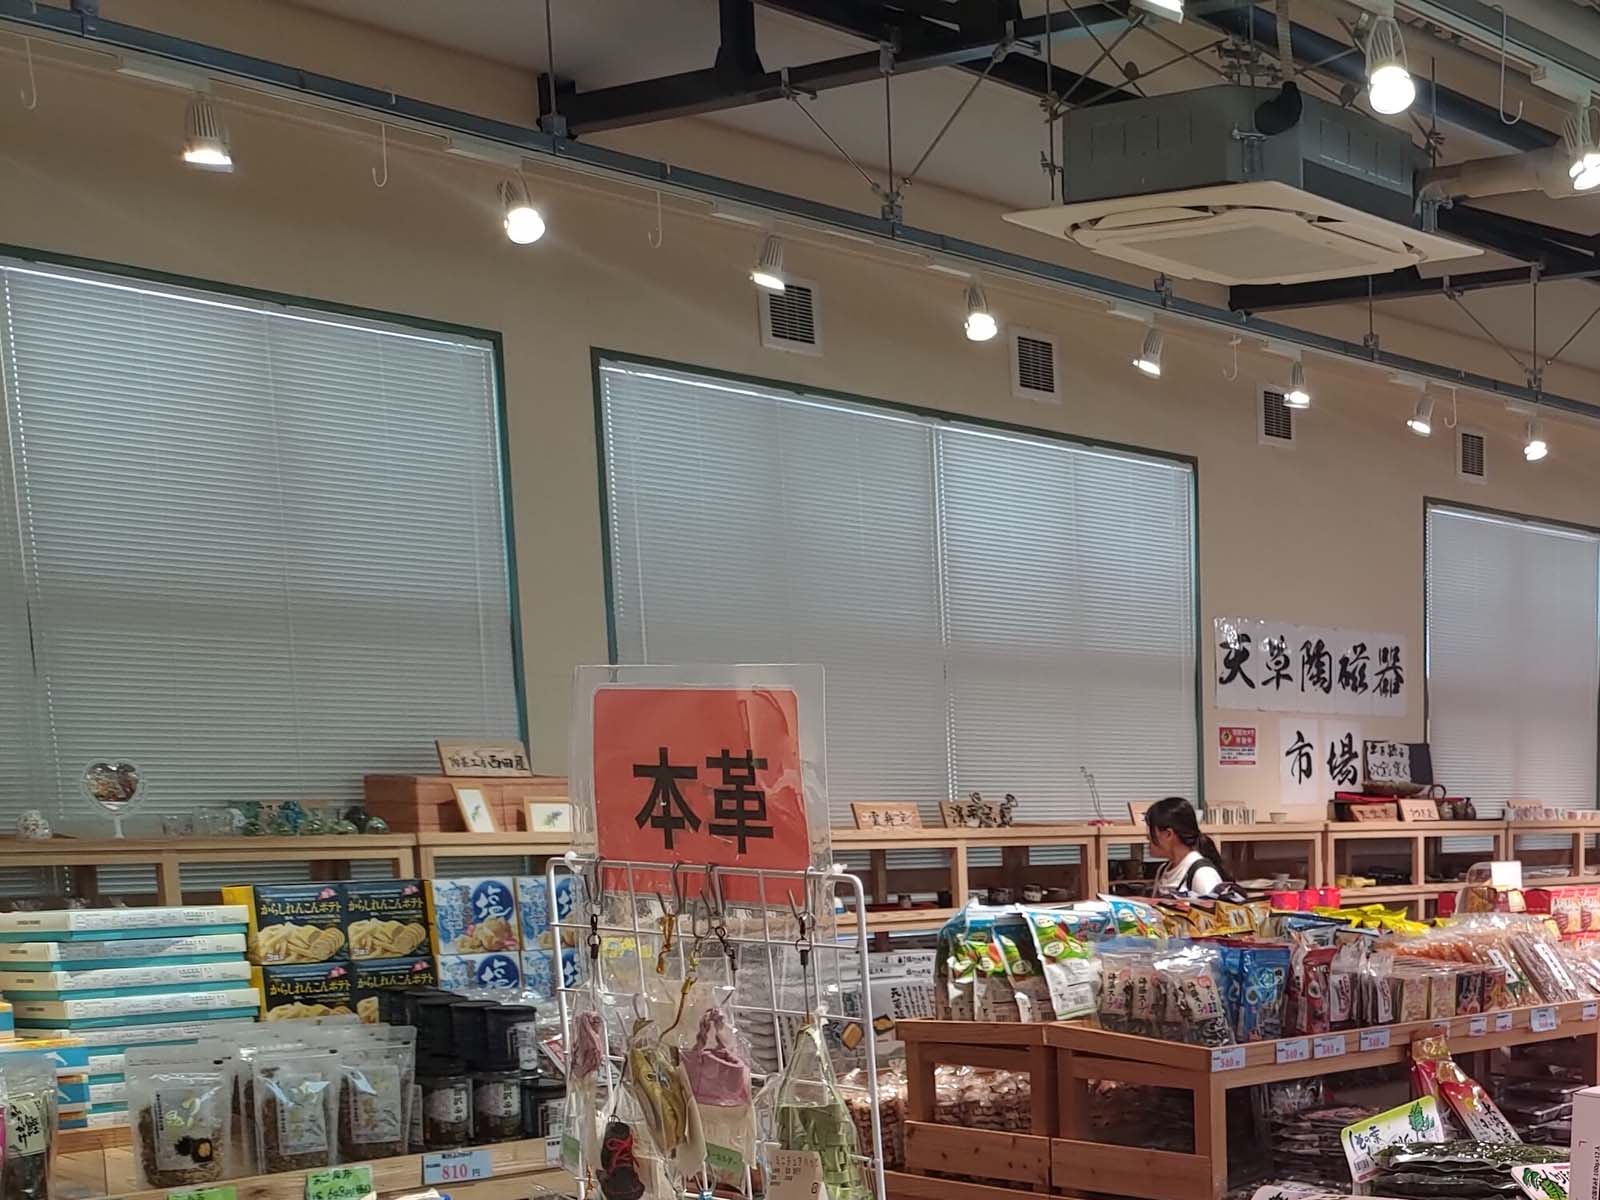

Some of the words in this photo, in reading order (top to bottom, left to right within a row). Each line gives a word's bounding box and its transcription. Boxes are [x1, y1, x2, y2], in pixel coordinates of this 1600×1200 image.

[1218, 633, 1405, 697] 天草陶磁器
[1285, 731, 1359, 786] 市場
[633, 747, 774, 854] 本革
[260, 901, 341, 916] からしれんこんポテト
[348, 898, 424, 913] からしれんこんポテト
[477, 889, 513, 921] 塩
[270, 980, 350, 997] からしれんこんポテト
[357, 972, 434, 989] からしれんこんポテト
[442, 1164, 468, 1179] 810
[472, 1168, 481, 1177] 円
